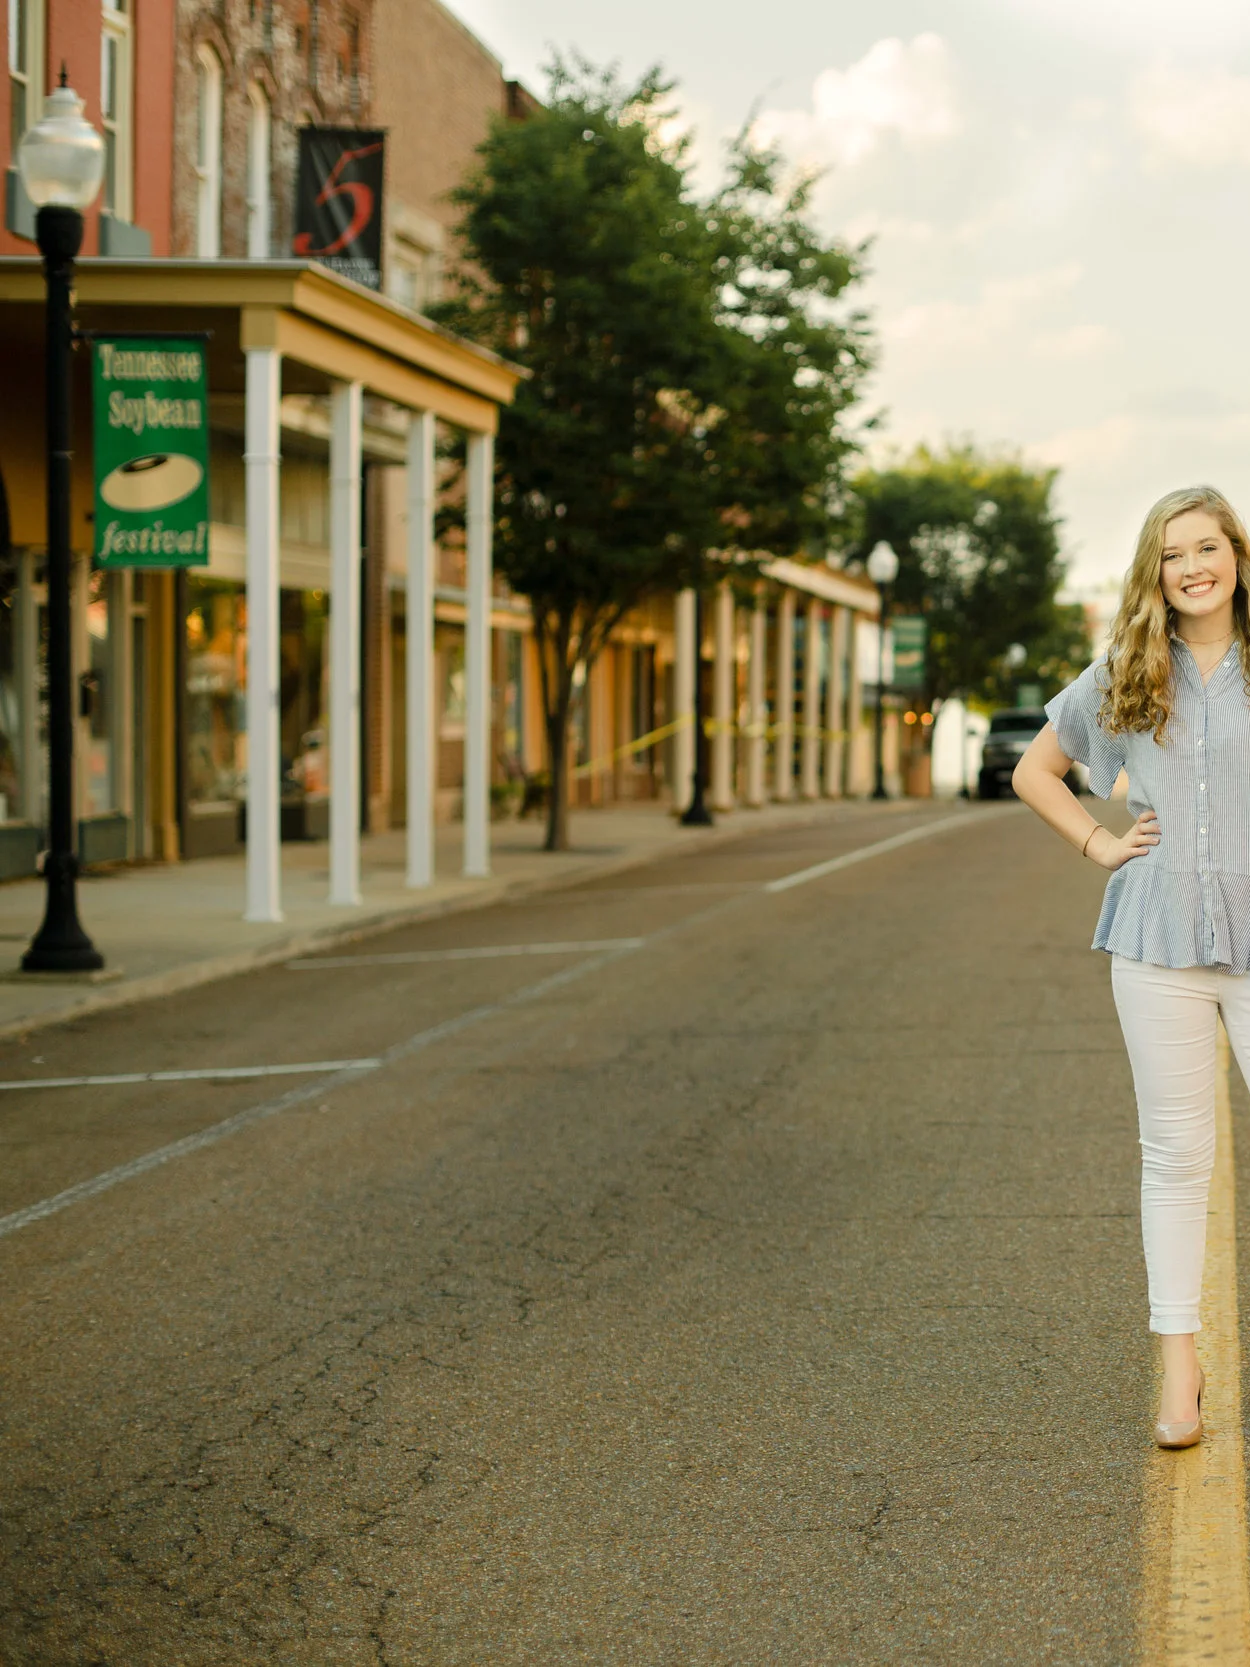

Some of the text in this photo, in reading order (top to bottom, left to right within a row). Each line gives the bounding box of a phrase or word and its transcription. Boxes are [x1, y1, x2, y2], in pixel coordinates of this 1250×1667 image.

[98, 343, 202, 382] Tennessee
[107, 390, 202, 436] Soybean
[98, 520, 209, 560] festival
